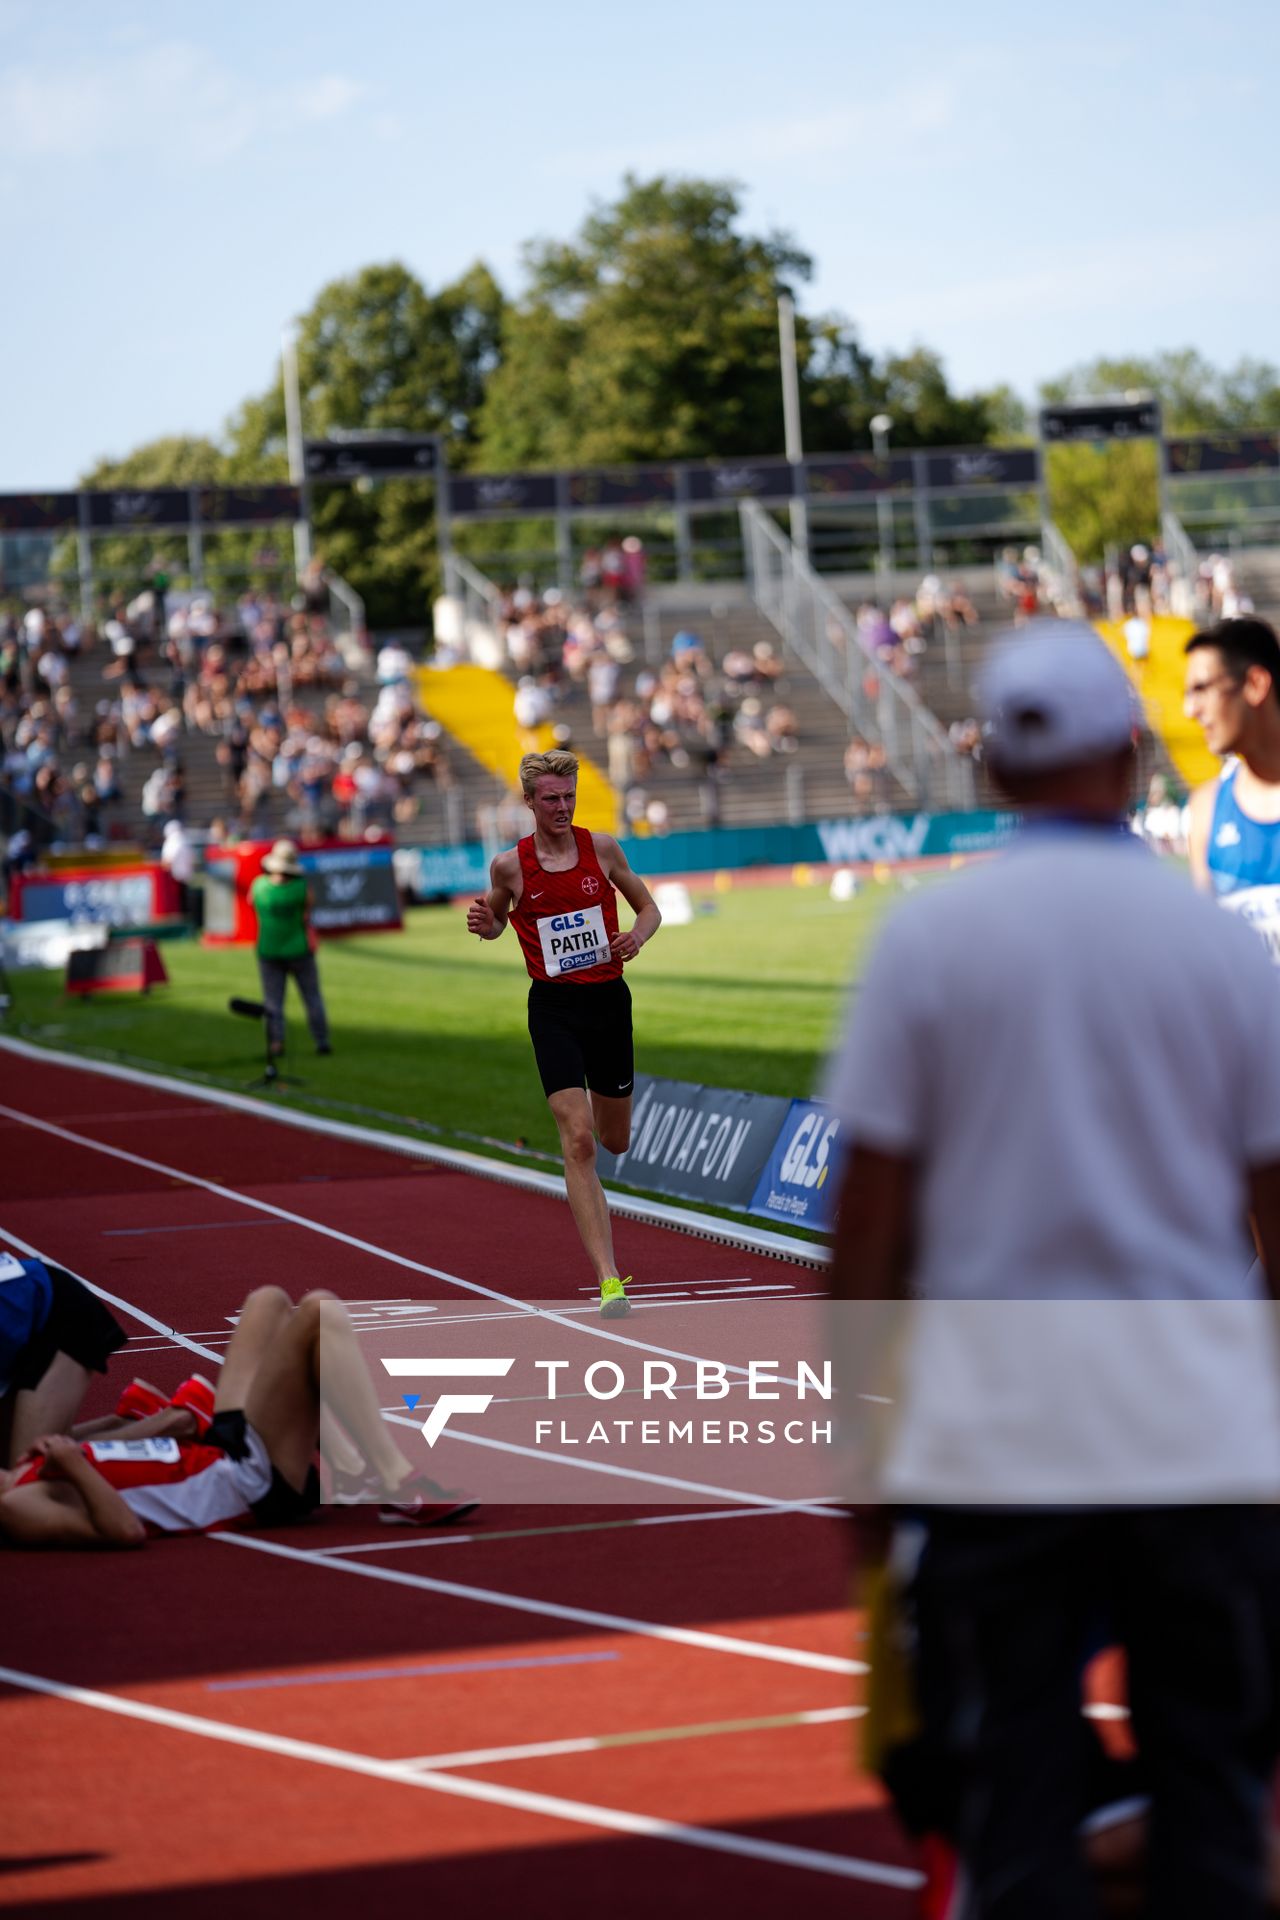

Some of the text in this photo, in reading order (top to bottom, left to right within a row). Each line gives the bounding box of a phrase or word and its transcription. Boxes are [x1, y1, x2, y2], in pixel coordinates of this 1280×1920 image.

[551, 929, 599, 955] PATRI
[574, 952, 596, 963] PLAN
[631, 1101, 752, 1182] NOVAFON
